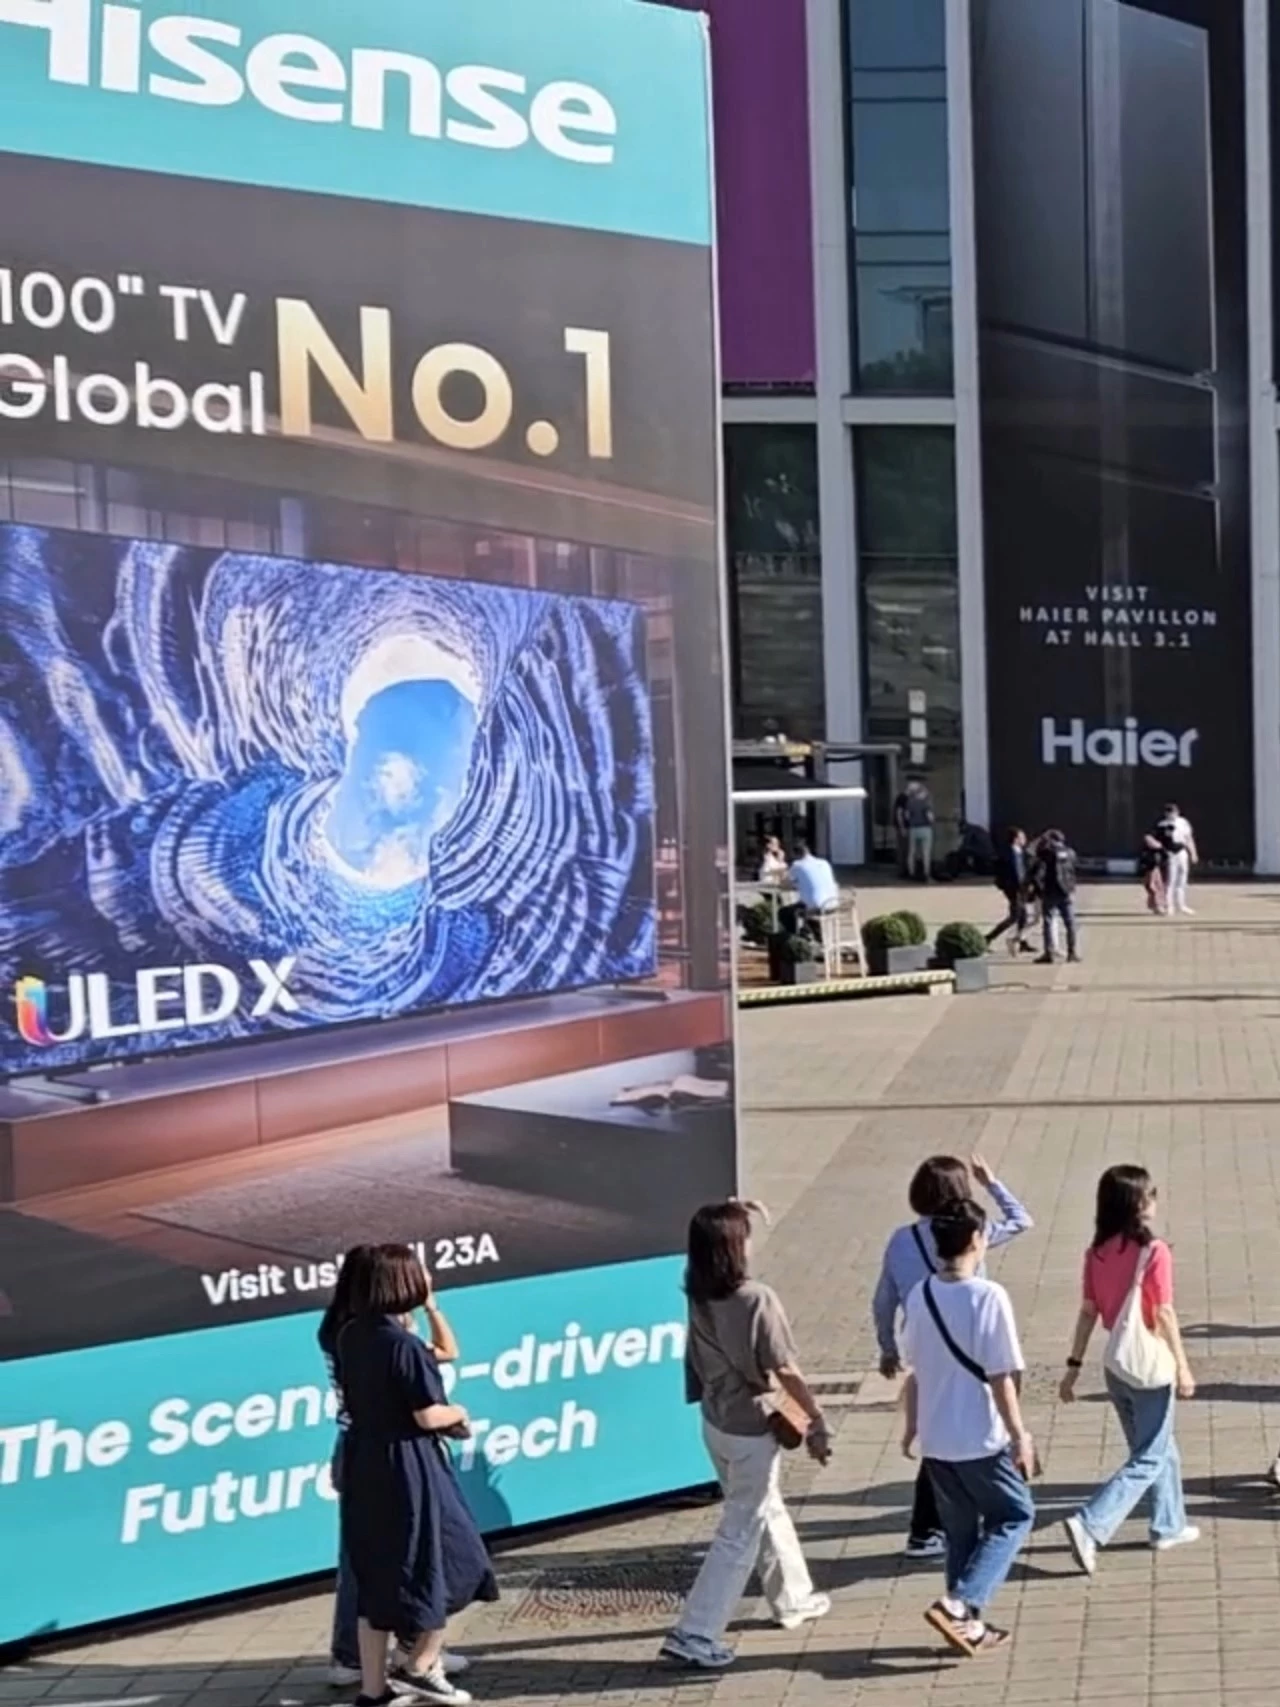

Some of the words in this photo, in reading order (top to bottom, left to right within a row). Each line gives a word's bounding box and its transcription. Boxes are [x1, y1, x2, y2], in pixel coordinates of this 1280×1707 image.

[0, 267, 143, 335] 100"
[160, 285, 247, 346] TV
[0, 354, 266, 436] Global
[275, 297, 615, 460] No.1
[1019, 607, 1089, 622] HAIER
[1101, 609, 1216, 625] PAVILLON
[1085, 586, 1149, 601] VISIT
[1045, 630, 1071, 644] AT
[1084, 631, 1141, 646] HALL
[1153, 632, 1191, 646] 3.1
[1042, 718, 1198, 767] Haier
[17, 965, 239, 1046] ULED
[251, 957, 299, 1018] X
[202, 1264, 286, 1306] Visit
[434, 1232, 500, 1270] 23A
[0, 1418, 130, 1487] The
[458, 1402, 597, 1473] Tech
